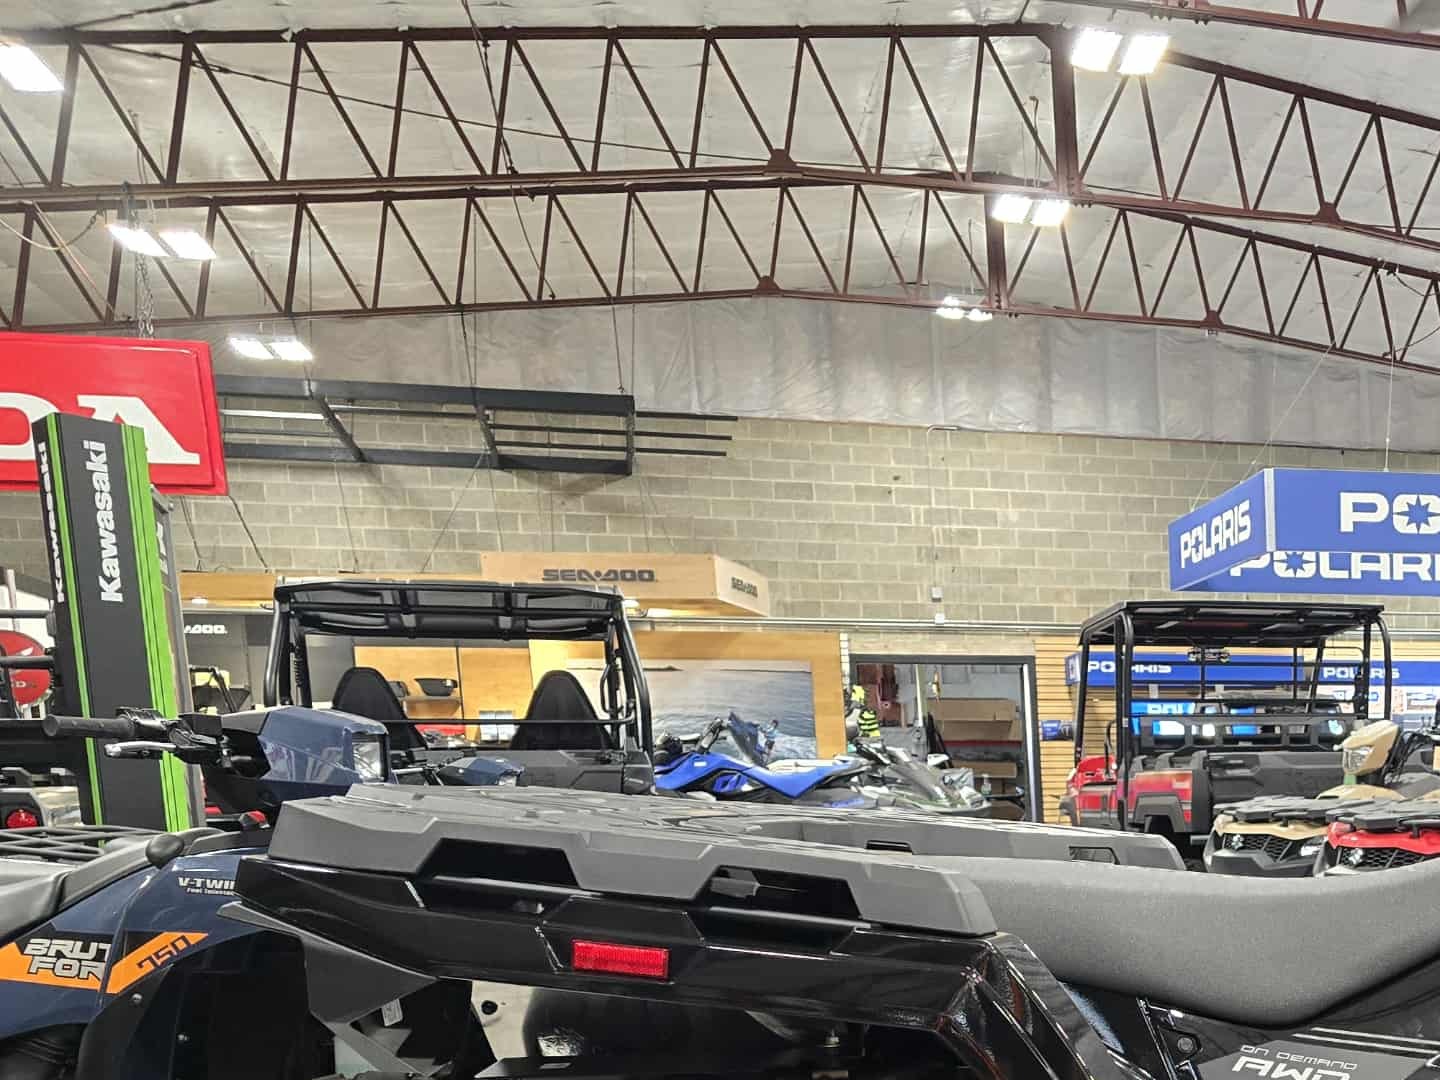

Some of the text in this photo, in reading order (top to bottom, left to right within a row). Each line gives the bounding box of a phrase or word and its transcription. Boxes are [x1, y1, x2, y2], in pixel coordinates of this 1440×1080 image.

[83, 440, 123, 602] Kawasaki
[1179, 499, 1251, 568] POLARIS
[23, 938, 112, 960] BRUT
[137, 934, 193, 970] 750
[28, 957, 105, 980] FOR
[1240, 1045, 1358, 1070] ON DEMAND
